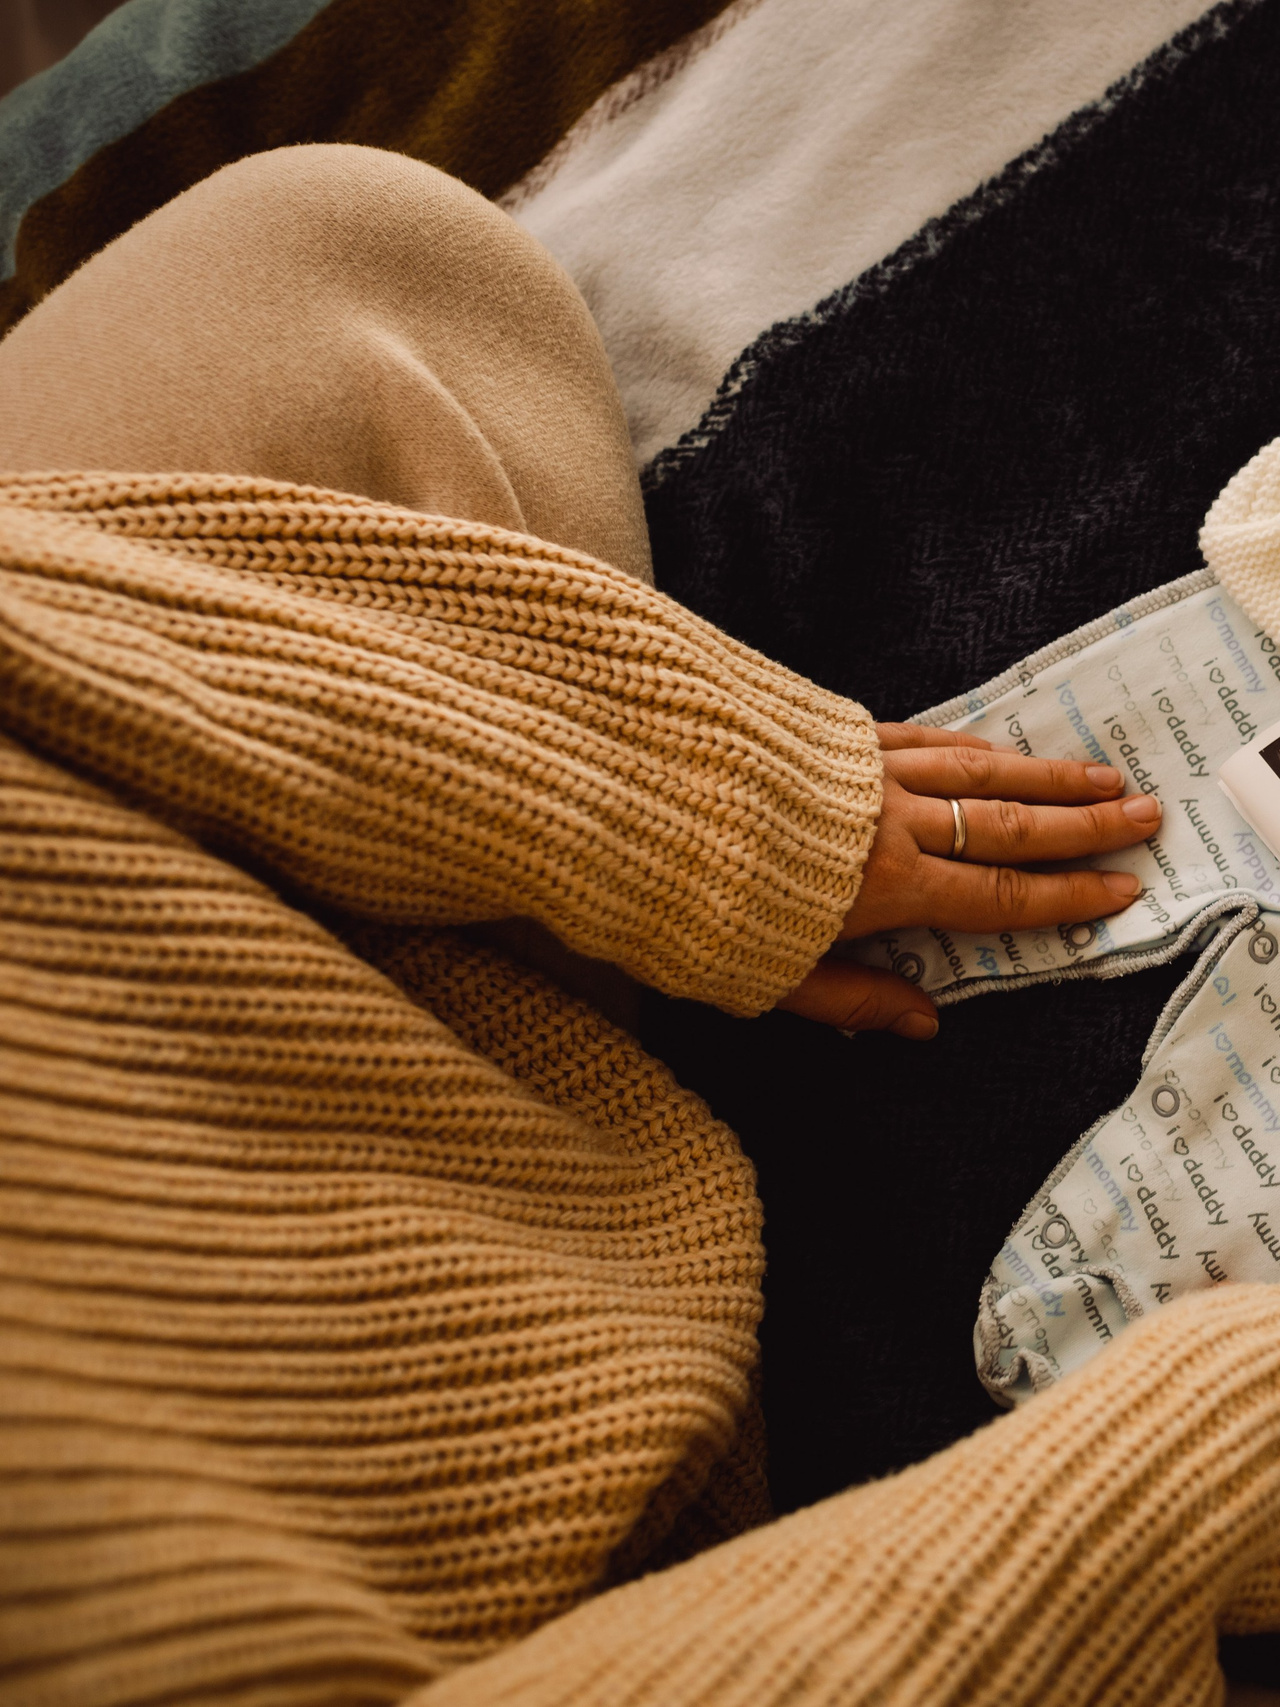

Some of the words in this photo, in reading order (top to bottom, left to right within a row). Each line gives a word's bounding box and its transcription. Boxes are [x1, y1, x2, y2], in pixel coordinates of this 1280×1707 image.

[1217, 623, 1267, 693] mommy
[1167, 716, 1209, 778] daddy
[1179, 798, 1229, 872] mommy
[1234, 831, 1274, 896] daddy
[1232, 1124, 1280, 1189] daddy
[1085, 1153, 1138, 1232] mommy
[1137, 1186, 1180, 1260] daddy
[1183, 1159, 1228, 1225] daddy
